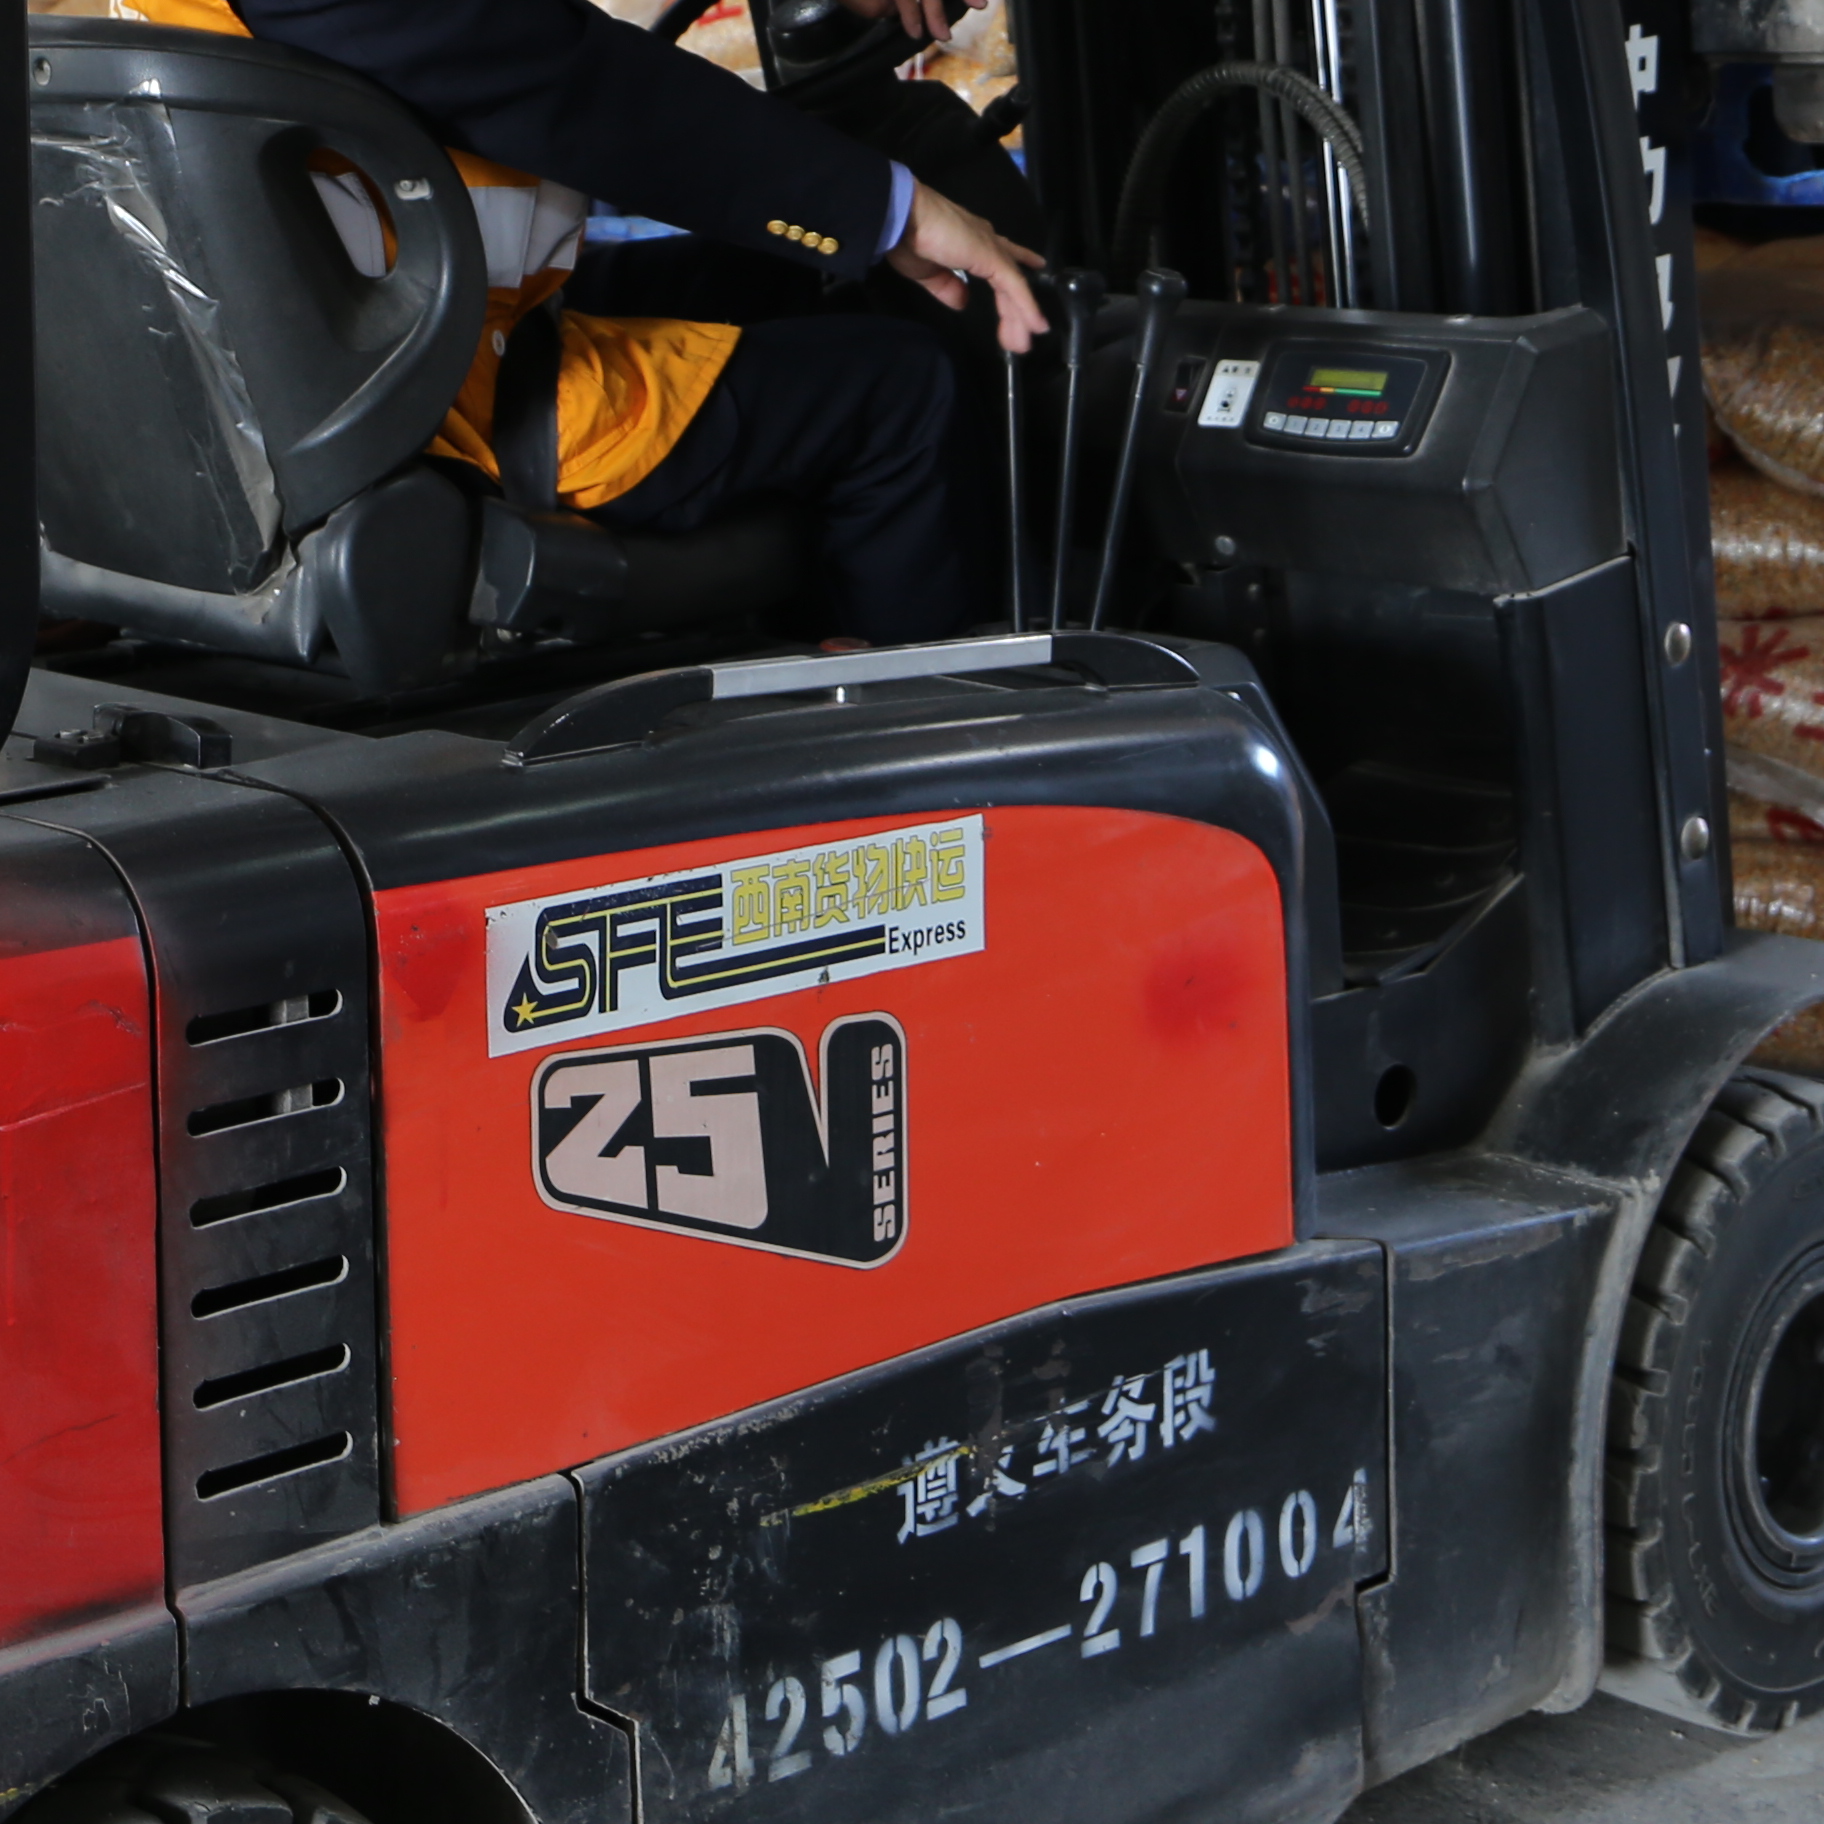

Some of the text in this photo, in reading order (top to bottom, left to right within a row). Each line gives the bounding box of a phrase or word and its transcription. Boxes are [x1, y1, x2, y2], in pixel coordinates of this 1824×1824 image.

[730, 828, 966, 947] 西南货物快运
[887, 917, 967, 956] Express
[870, 1042, 895, 1243] SERIES
